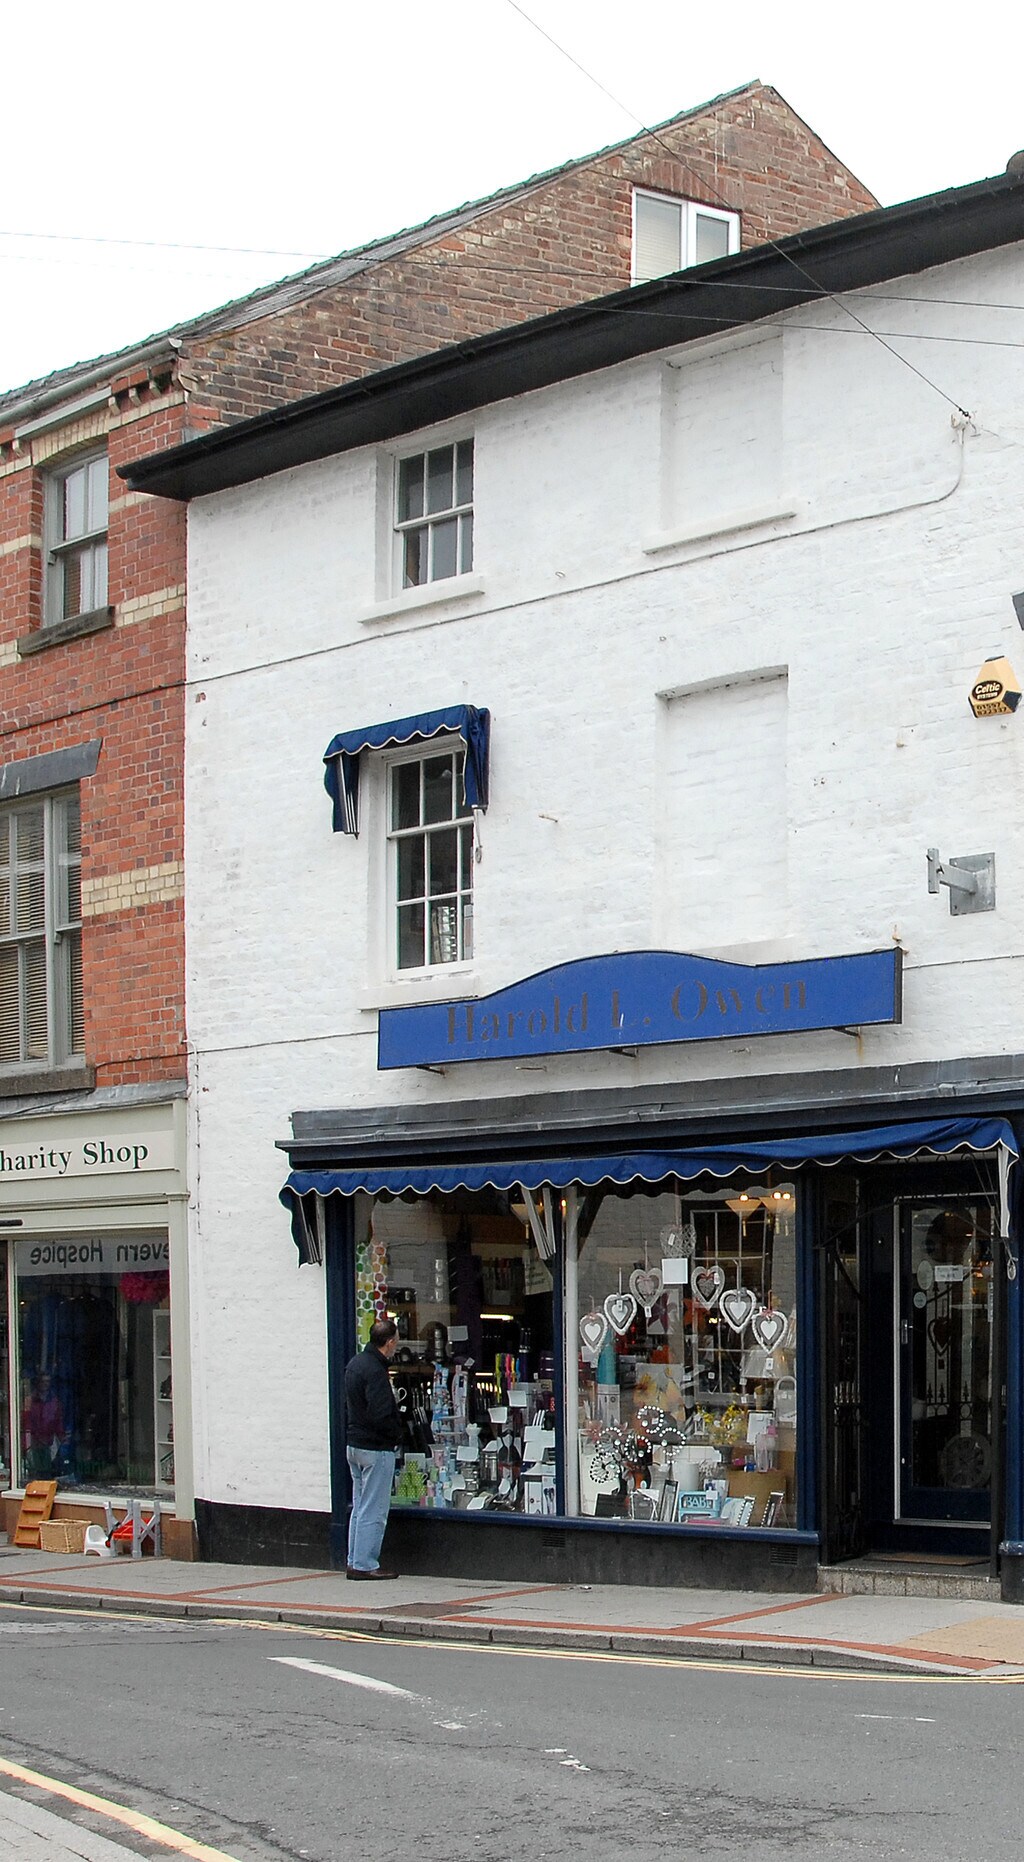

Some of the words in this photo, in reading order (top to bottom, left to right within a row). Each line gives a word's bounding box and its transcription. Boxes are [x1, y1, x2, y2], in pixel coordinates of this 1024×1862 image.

[975, 682, 1000, 694] Celtic
[447, 992, 588, 1045] Harold
[670, 979, 807, 1022] Owen
[83, 1141, 148, 1169] Shop
